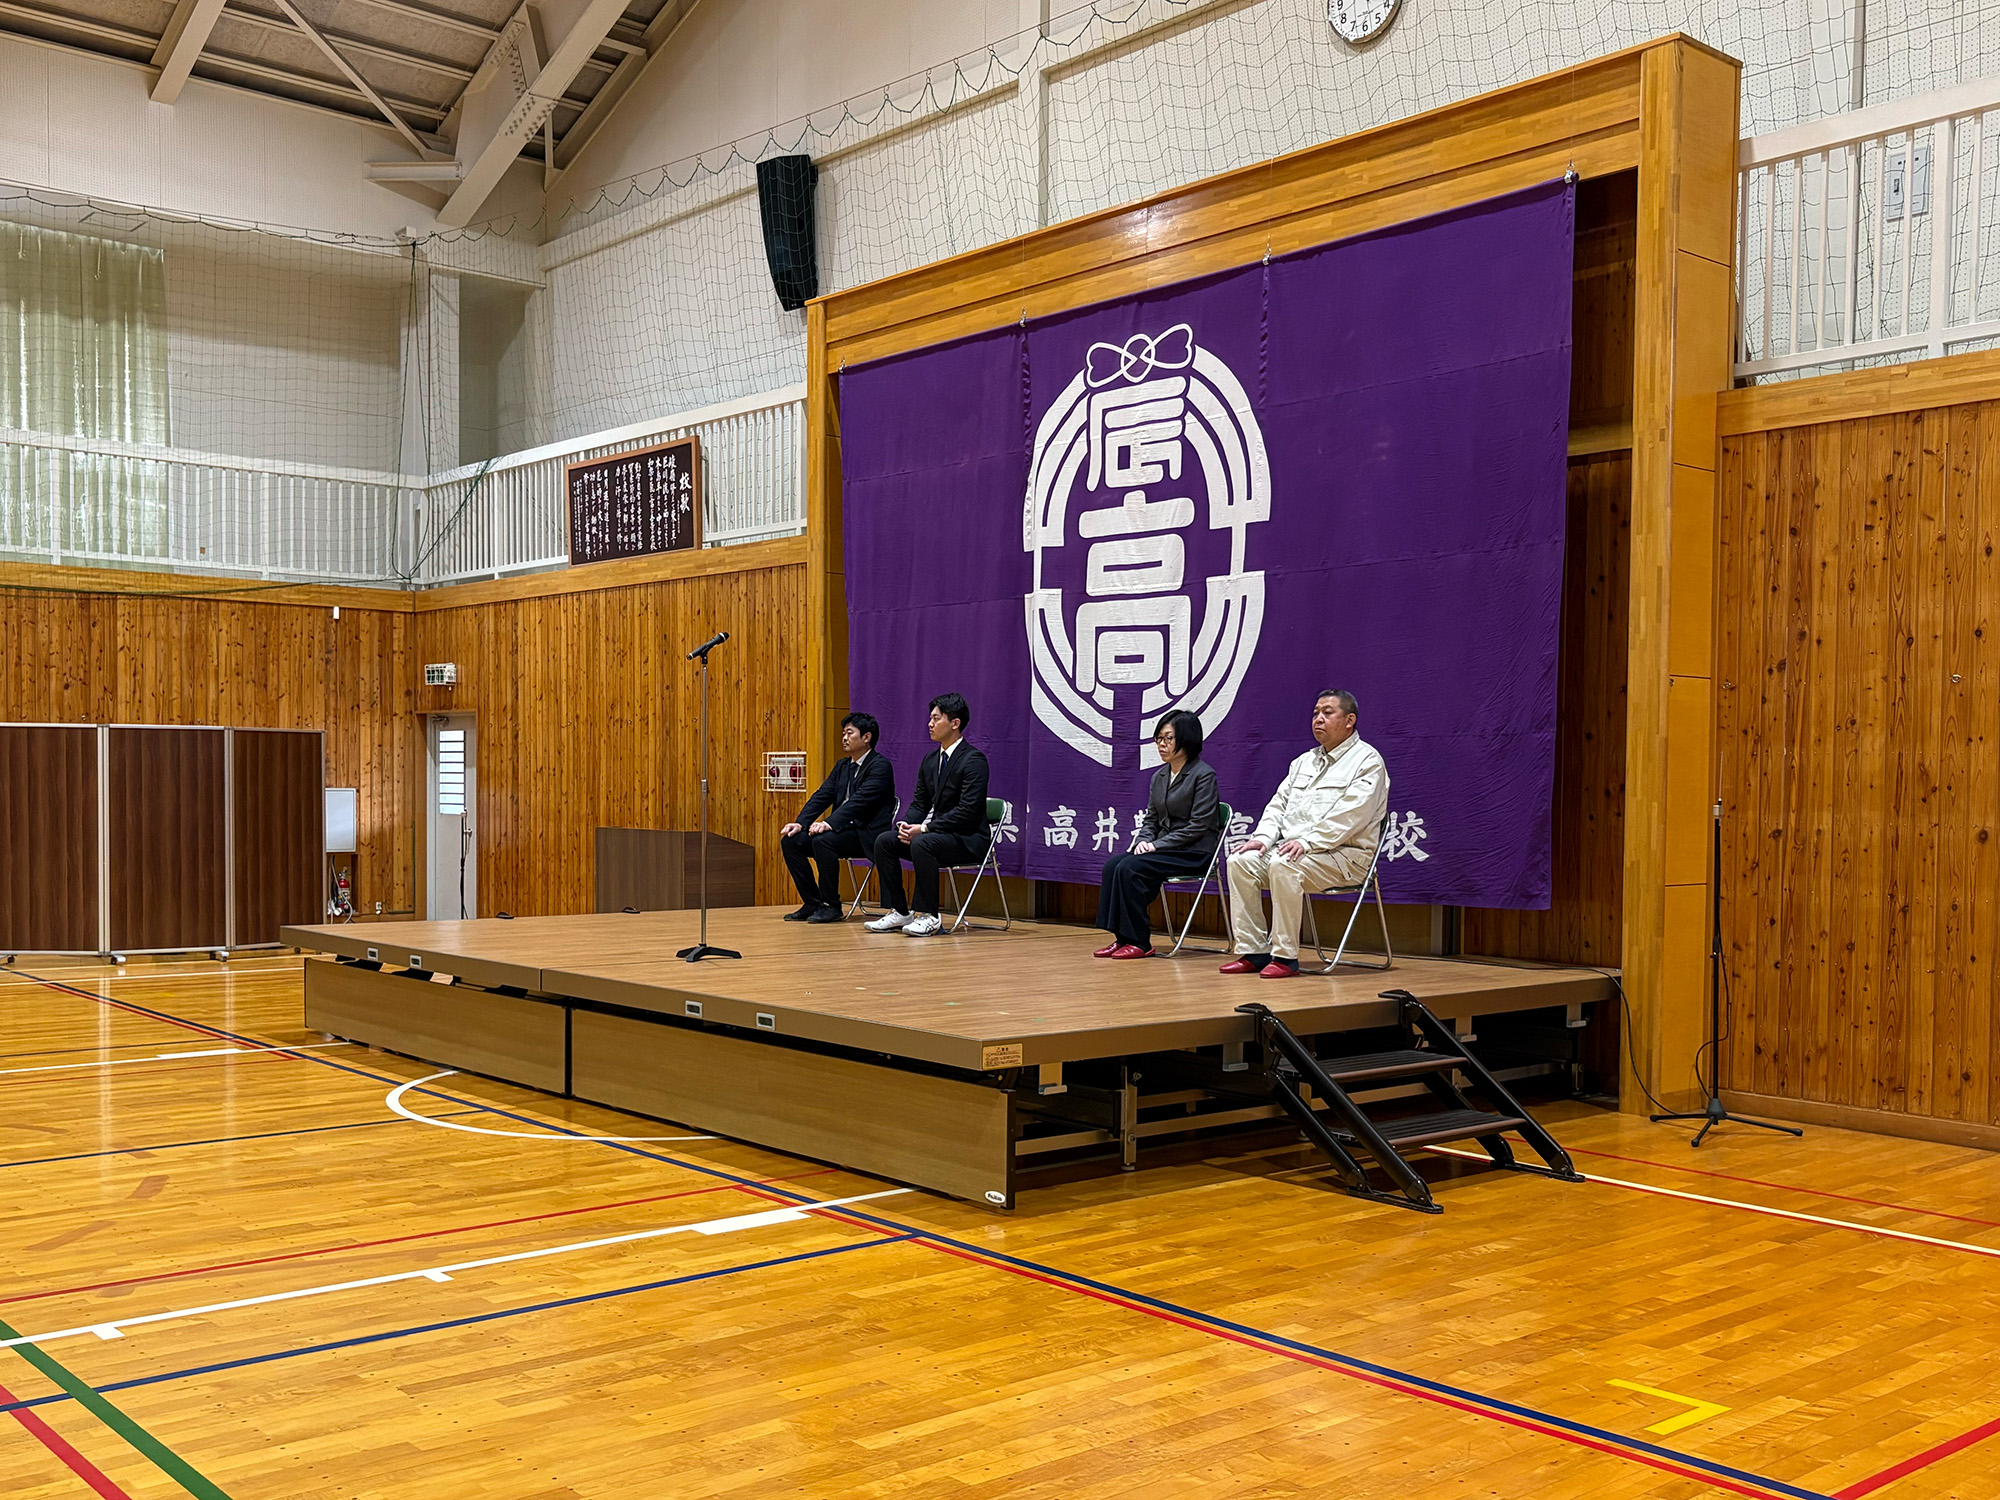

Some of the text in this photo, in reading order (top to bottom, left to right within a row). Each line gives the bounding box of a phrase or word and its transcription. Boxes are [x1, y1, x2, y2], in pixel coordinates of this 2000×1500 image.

[1337, 0, 1343, 10] 9
[1341, 13, 1347, 24] 8
[1375, 13, 1381, 24] 5
[1350, 21, 1356, 31] 7
[1362, 21, 1368, 32] 6
[1381, 811, 1429, 862] 校
